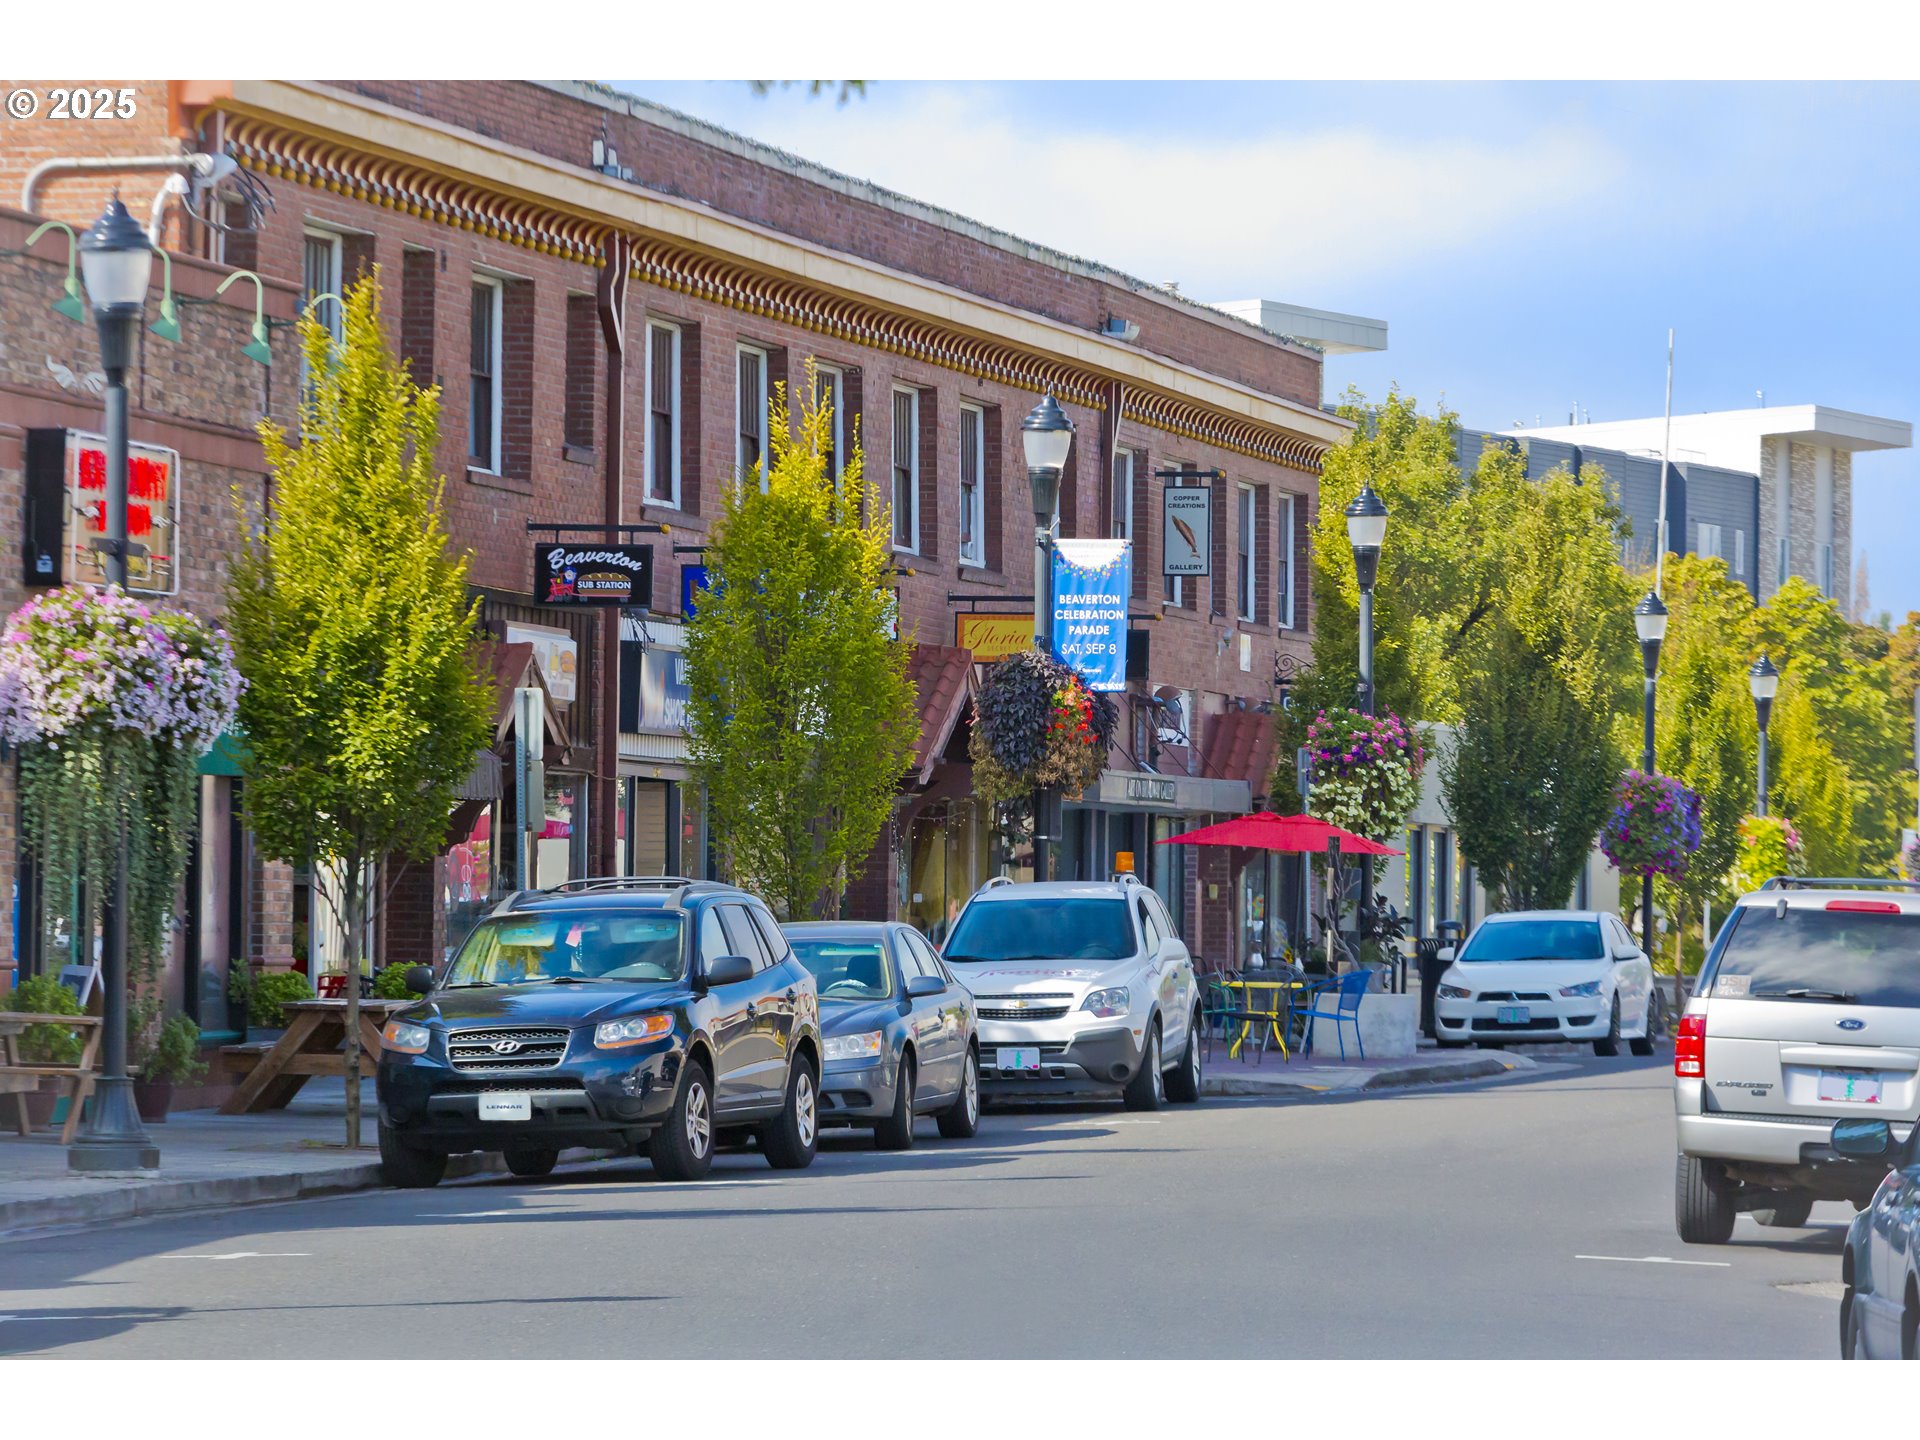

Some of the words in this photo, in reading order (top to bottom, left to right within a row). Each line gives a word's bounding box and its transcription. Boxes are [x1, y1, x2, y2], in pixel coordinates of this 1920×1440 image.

[547, 547, 642, 571] Beaverton
[577, 581, 594, 589] SUB
[596, 581, 631, 590] STATION
[1059, 594, 1120, 604] BEAVERTON
[1054, 609, 1124, 620] CELEBRATION
[1068, 625, 1110, 635] PARADE
[1061, 643, 1082, 656] SAT,
[1085, 643, 1106, 654] SEP
[1108, 643, 1117, 655] 8
